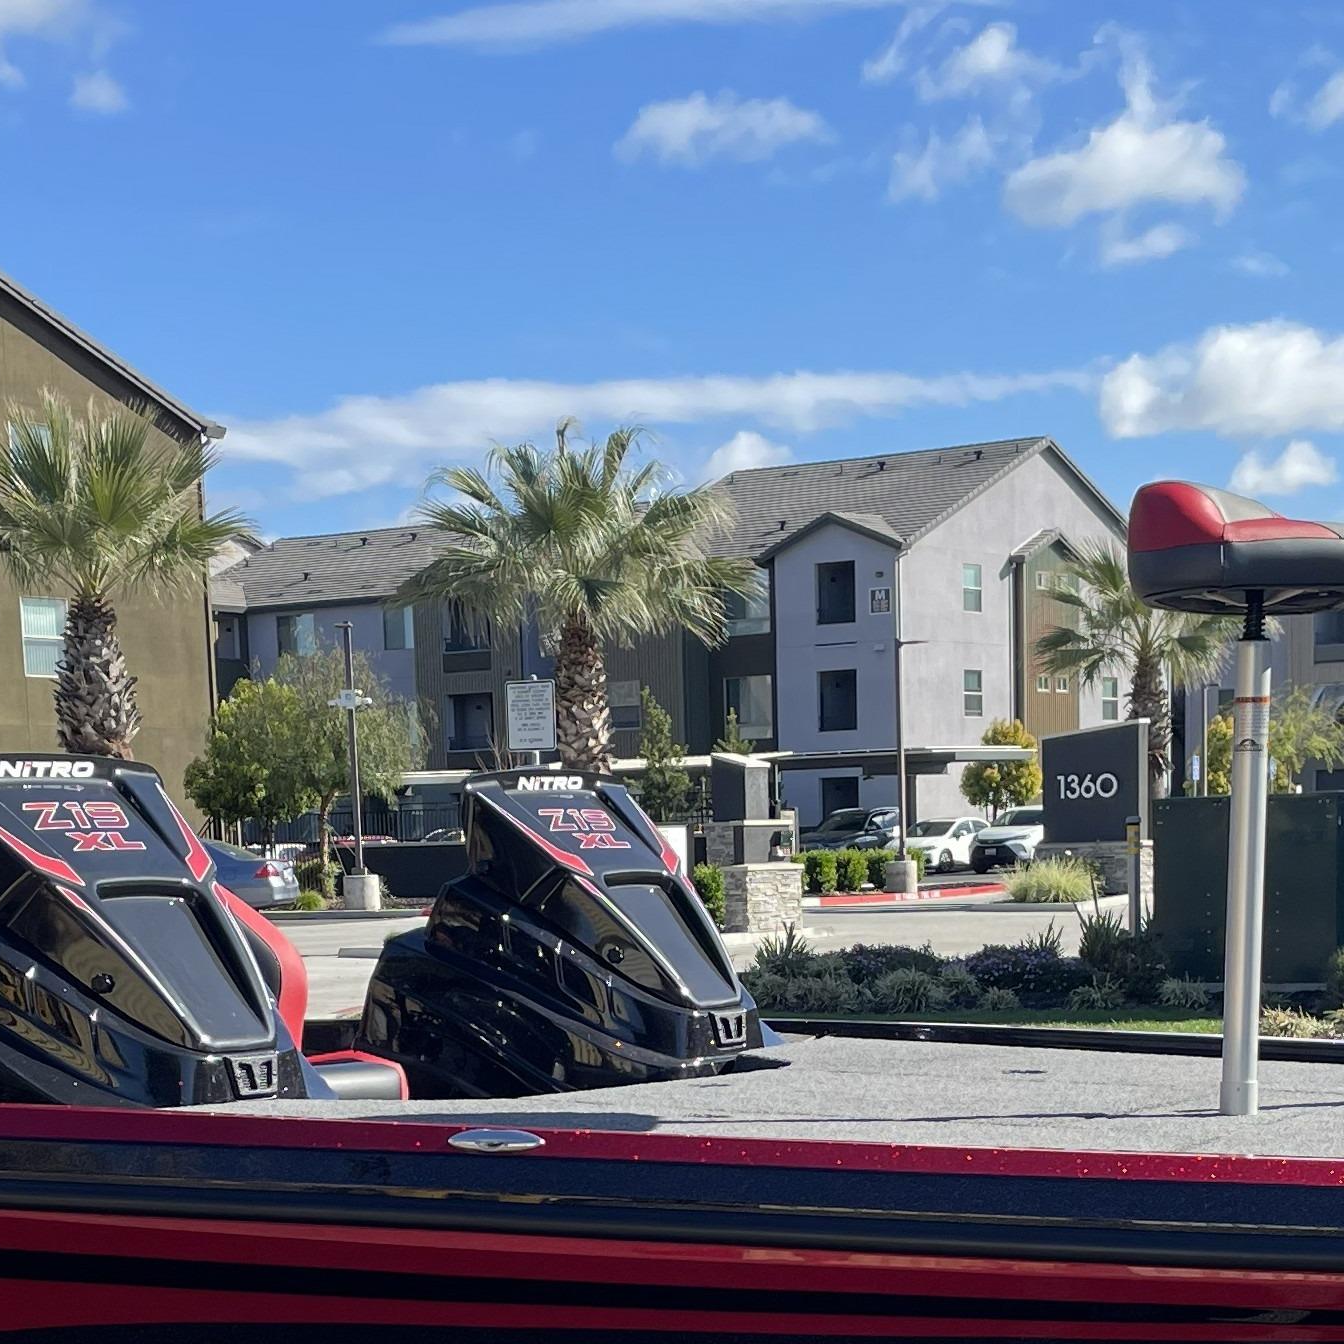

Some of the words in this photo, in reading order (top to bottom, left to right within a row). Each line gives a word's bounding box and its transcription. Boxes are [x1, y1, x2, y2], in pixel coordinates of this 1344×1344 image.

[1056, 773, 1118, 799] 1360
[65, 831, 147, 852] XL
[572, 833, 632, 849] XL
